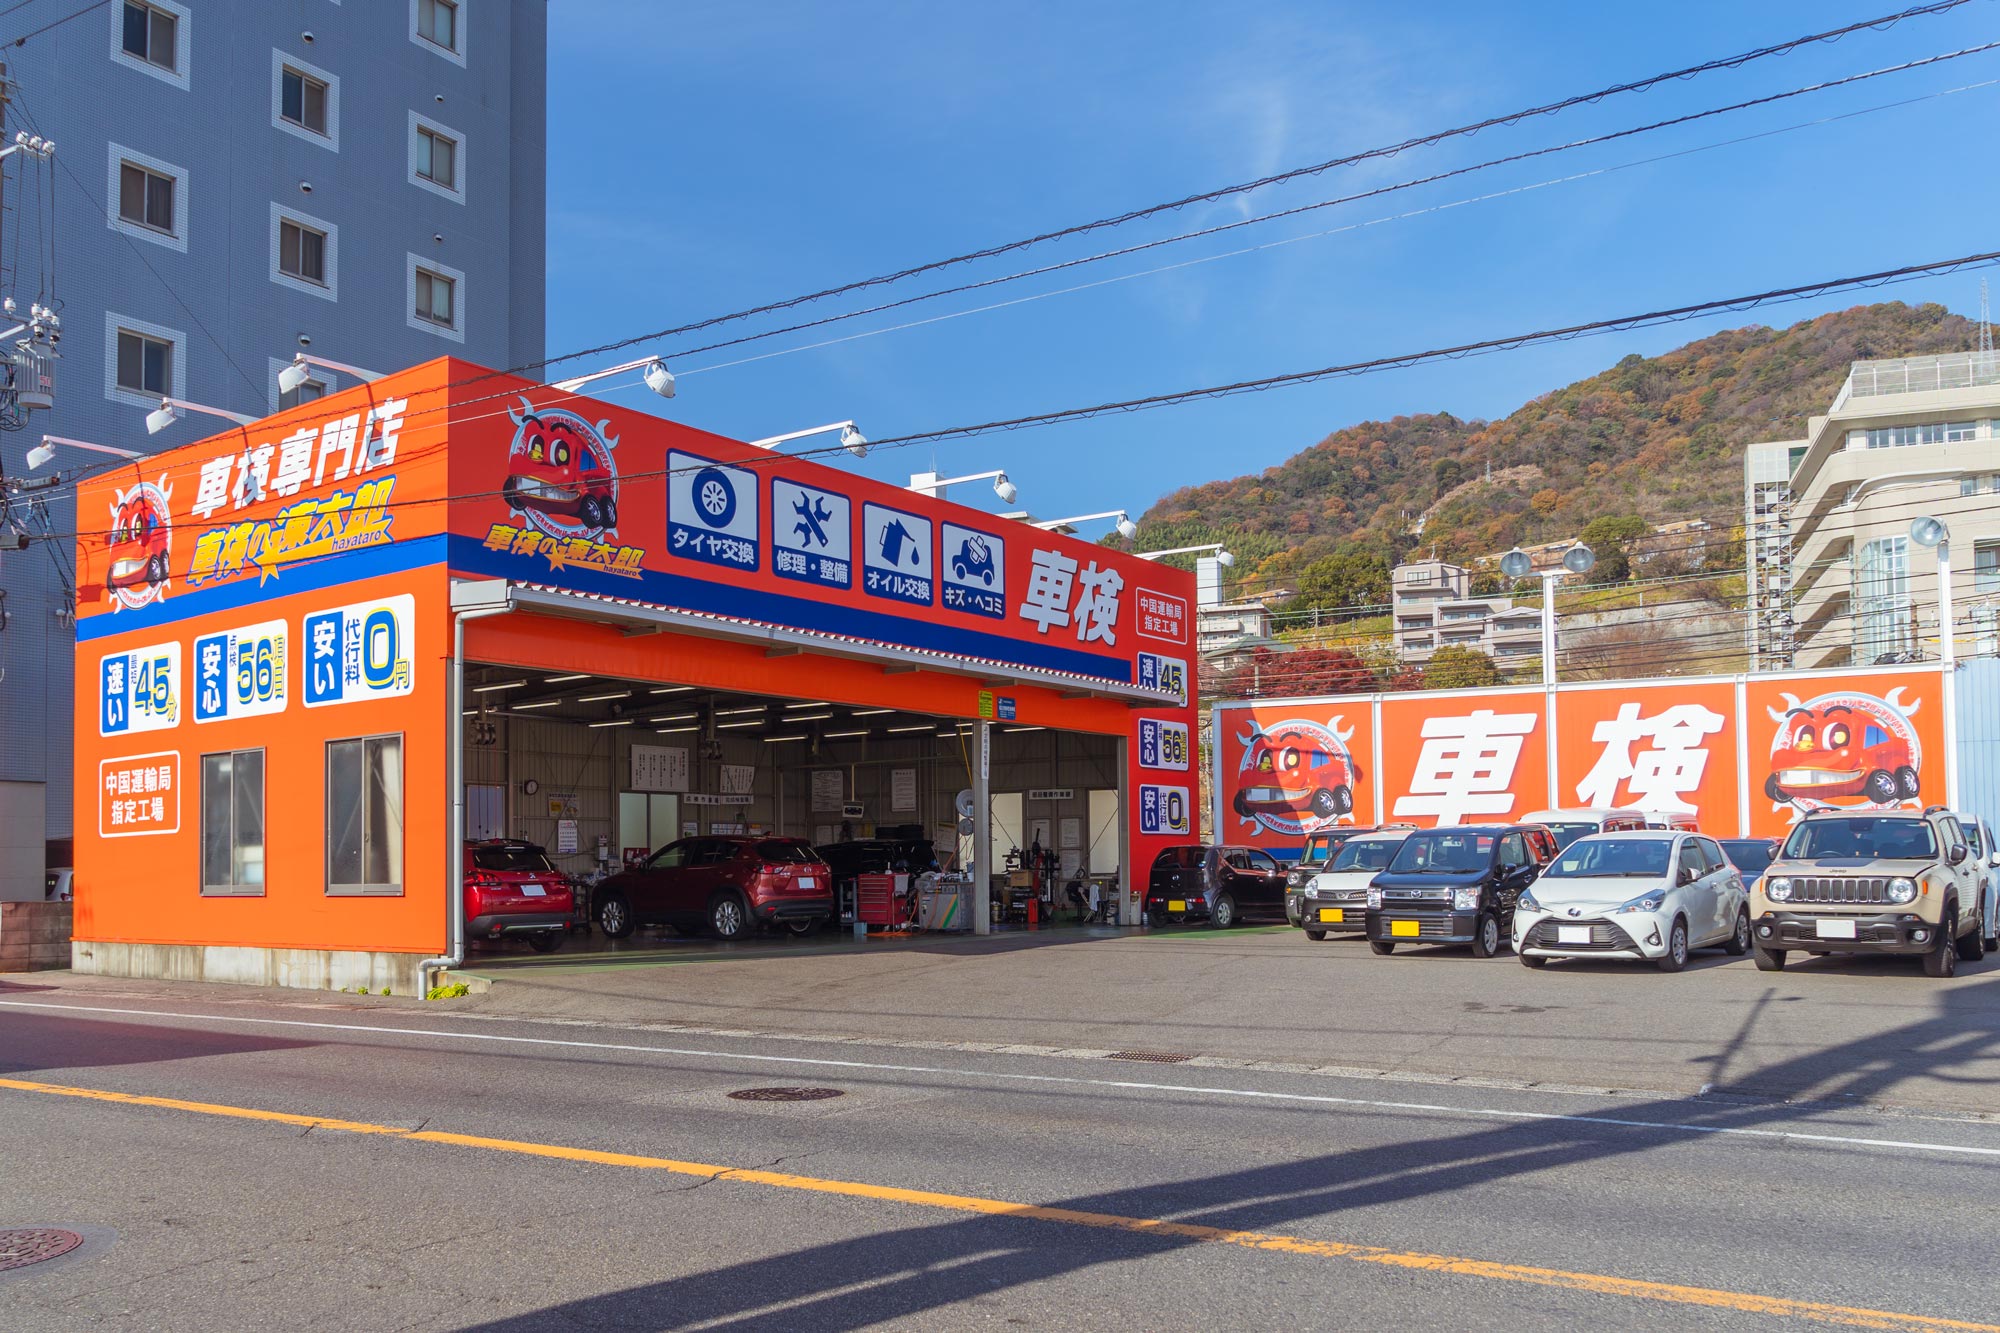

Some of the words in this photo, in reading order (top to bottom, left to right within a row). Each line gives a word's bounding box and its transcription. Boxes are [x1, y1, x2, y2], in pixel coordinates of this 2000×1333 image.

[192, 397, 408, 520] 車検専門店
[331, 528, 382, 551] hayataro
[673, 528, 755, 565] タイヤ交換
[603, 564, 637, 577] hayataro
[776, 550, 848, 584] 修理・整備
[867, 571, 930, 601] オイル交換
[945, 587, 1003, 615] キズ・ヘコミ
[1020, 549, 1124, 646] 車検
[1140, 596, 1182, 620] 中国運輸局
[1144, 614, 1178, 636] 指定工場
[313, 620, 336, 696] 安い
[345, 618, 360, 687] 代行料
[107, 661, 124, 728] 速い
[202, 642, 222, 714] 安心
[1143, 723, 1155, 764] 安心
[105, 765, 172, 797] 中国運輸局
[111, 796, 165, 826] 指定工場
[1144, 789, 1156, 829] 安い
